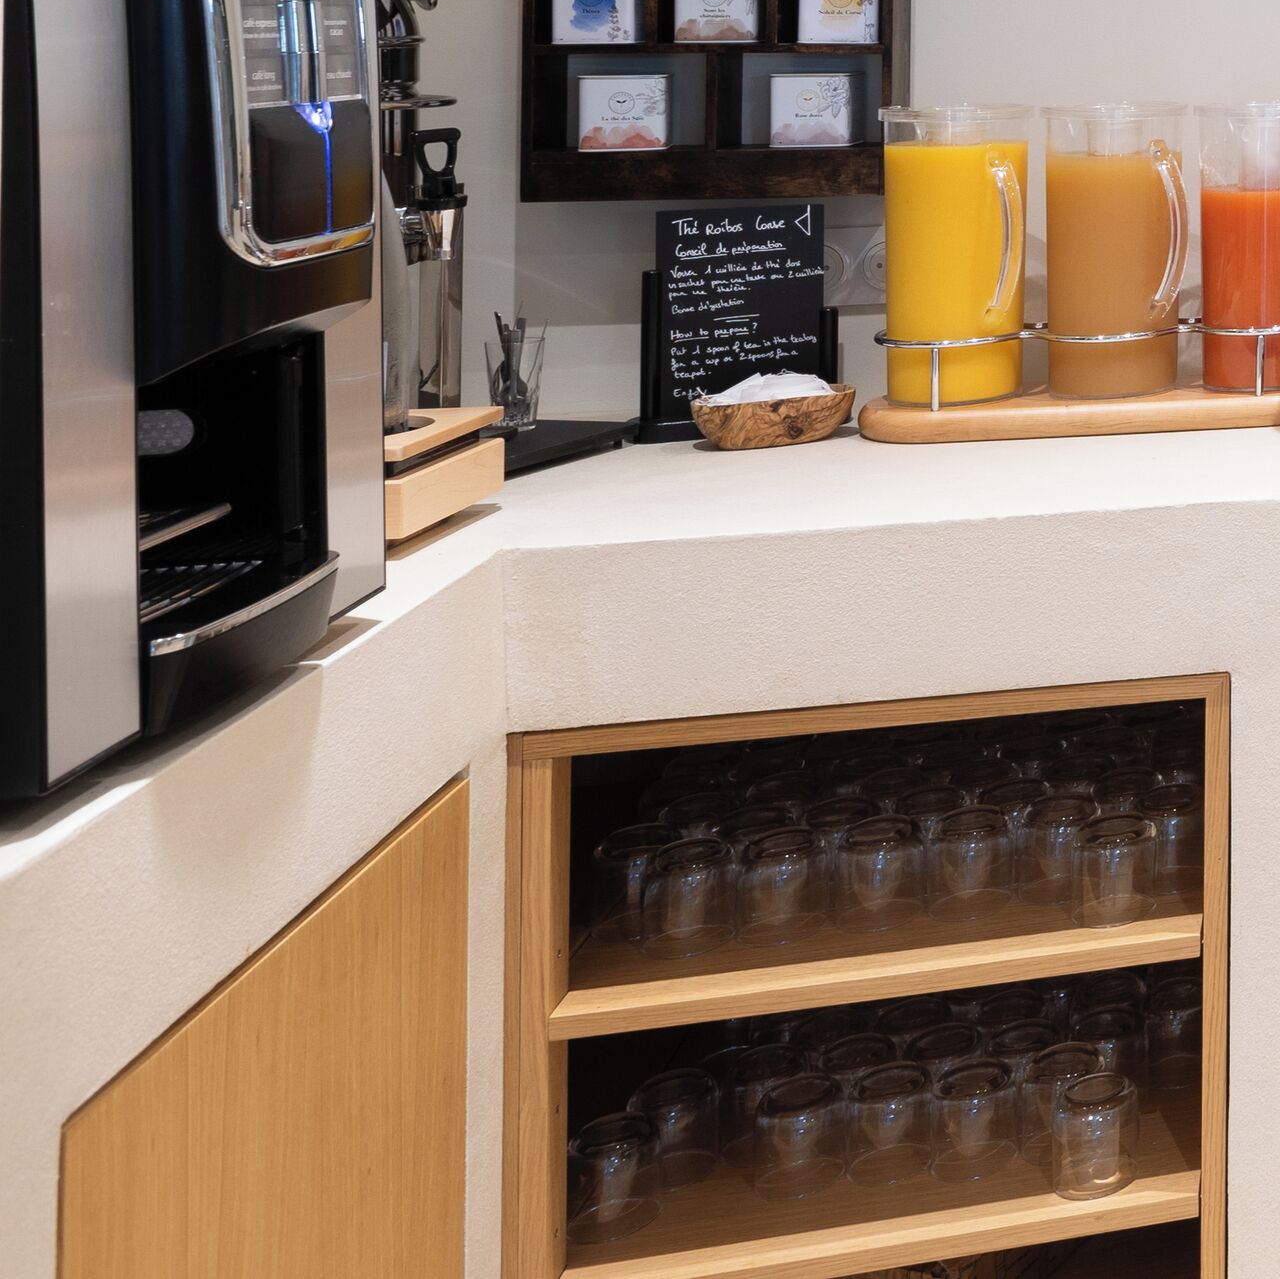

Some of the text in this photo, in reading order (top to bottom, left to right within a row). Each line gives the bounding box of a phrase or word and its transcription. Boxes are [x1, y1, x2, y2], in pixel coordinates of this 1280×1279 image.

[672, 217, 699, 236] Thé
[756, 214, 786, 231] Corse
[675, 242, 708, 258] Conseil
[716, 242, 729, 254] de
[751, 261, 763, 271] de
[766, 258, 780, 269] thé
[788, 270, 794, 279] 2
[671, 297, 745, 315] Bonne dégustation
[670, 329, 693, 341] How
[699, 328, 709, 336] to
[752, 322, 758, 334] ?
[670, 347, 687, 356] Put
[706, 346, 730, 355] spoon
[744, 341, 760, 349] tea
[773, 336, 788, 345] the
[705, 358, 719, 366] cup
[739, 352, 747, 361] 2
